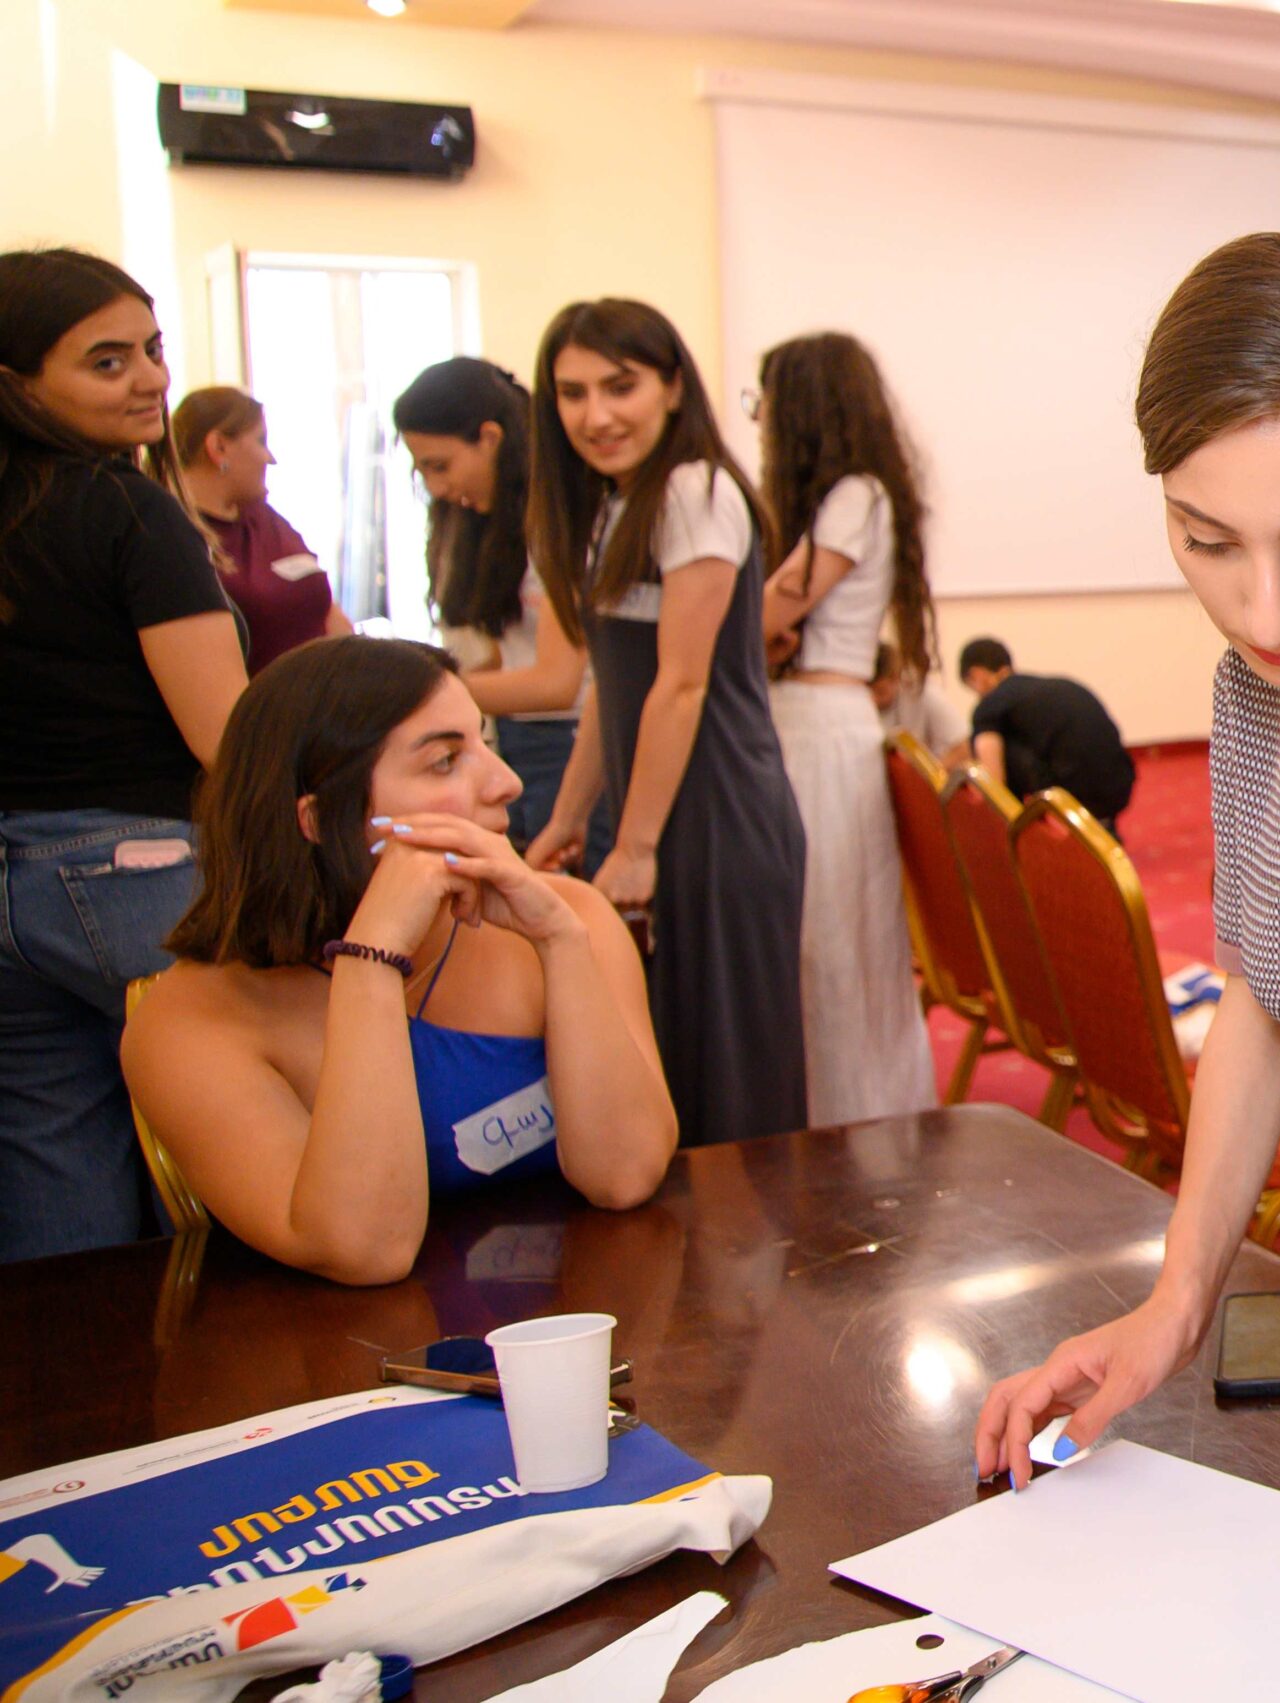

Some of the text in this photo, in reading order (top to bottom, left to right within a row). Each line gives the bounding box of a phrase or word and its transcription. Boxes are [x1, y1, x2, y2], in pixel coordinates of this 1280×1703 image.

[483, 1104, 554, 1148] Գայ
[123, 1476, 530, 1606] ԻՏԱՍԱՐԴԱ
[198, 1459, 440, 1558] ՃԱՄԲԱՐ
